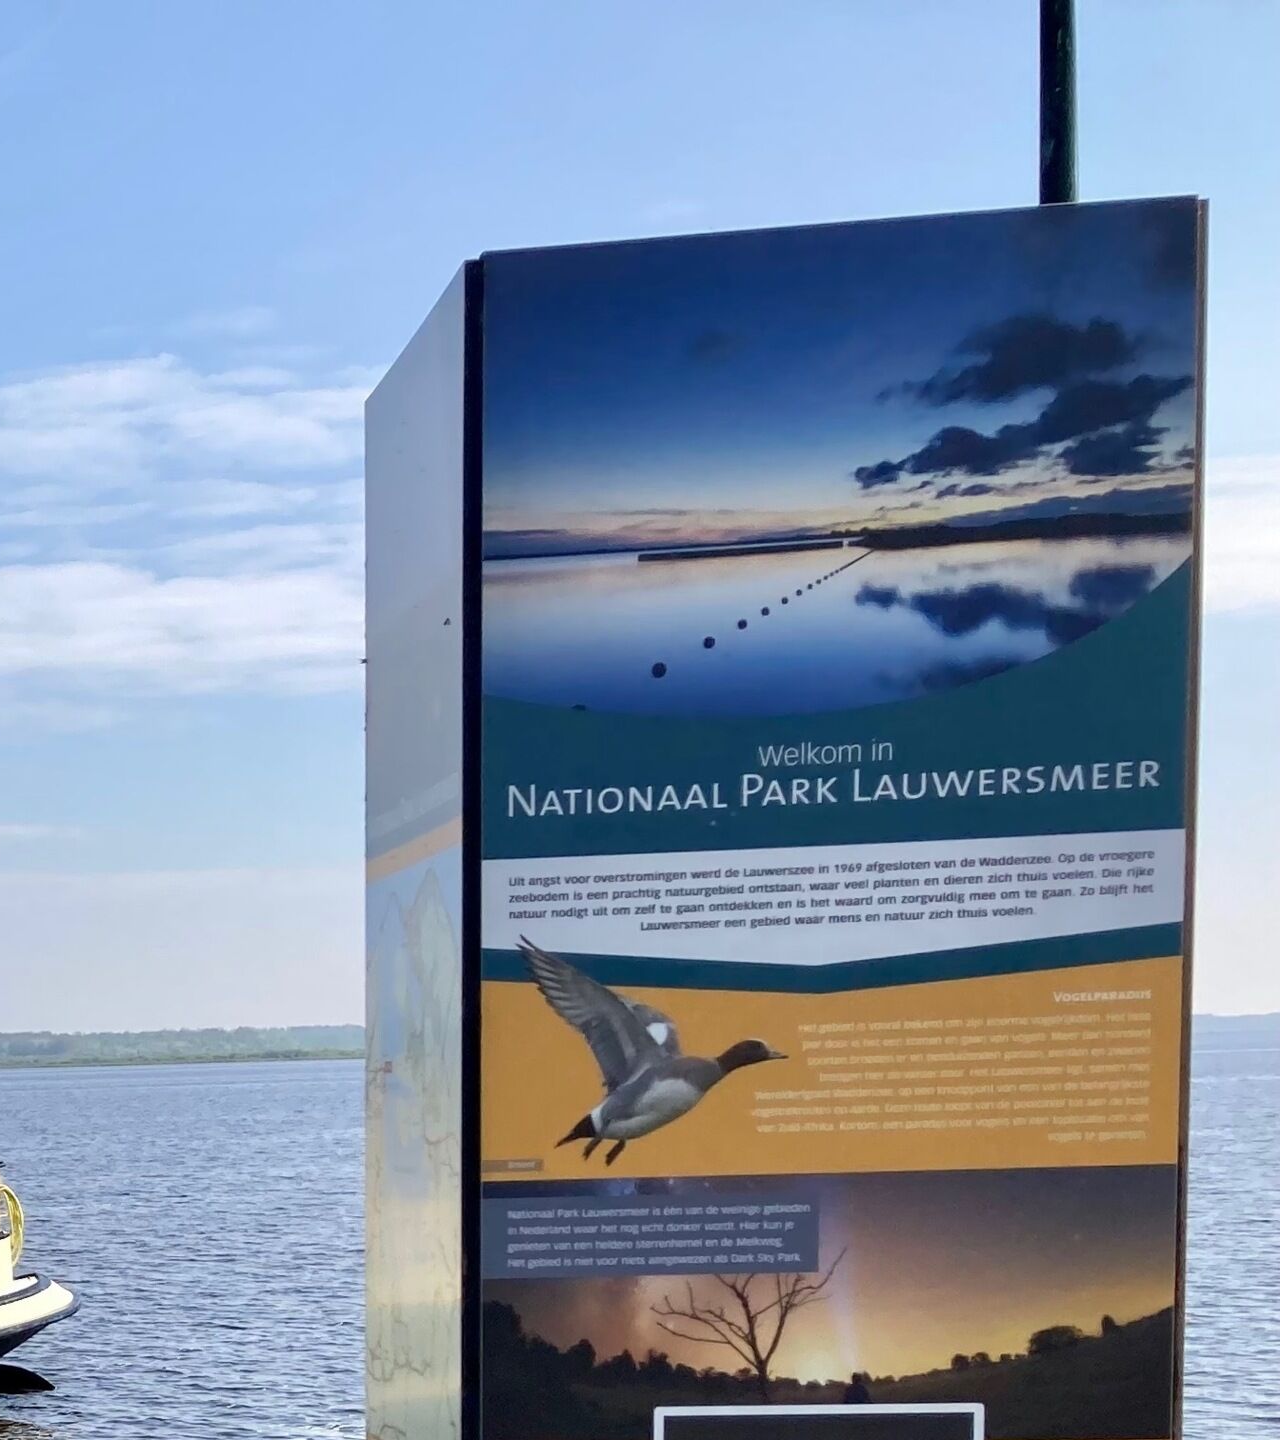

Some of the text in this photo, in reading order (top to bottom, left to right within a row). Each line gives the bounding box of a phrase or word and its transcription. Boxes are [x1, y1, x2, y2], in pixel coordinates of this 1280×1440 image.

[758, 739, 893, 768] Welkom in
[508, 760, 1160, 818] NATIONAAL PARK LAUWERSMEER
[508, 876, 526, 887] Uit
[528, 875, 561, 888] angst
[563, 875, 592, 885] voor
[593, 871, 687, 884] overstromingen
[690, 868, 722, 880] werd
[724, 867, 740, 879] de
[742, 866, 815, 878] Lauwerszee
[818, 864, 830, 875] in
[834, 862, 863, 874] 1969
[865, 860, 931, 874] afgesloten
[933, 859, 957, 869] van
[959, 857, 976, 868] de
[1057, 853, 1076, 864] Op
[1079, 852, 1096, 863] de
[1098, 850, 1155, 863] vroegere
[508, 892, 570, 904] zeebodem
[573, 890, 583, 901] is
[586, 891, 609, 901] een
[611, 888, 662, 901] prachtig
[664, 884, 745, 898] natuurgebied
[808, 881, 841, 892] waar
[843, 879, 869, 890] veel
[872, 878, 920, 891] planten
[923, 877, 940, 887] en
[943, 874, 984, 886] dieren
[987, 872, 1013, 884] zich
[1016, 871, 1048, 882] thuis
[1101, 868, 1123, 879] Die
[1126, 866, 1155, 879] rijke
[508, 909, 548, 920] natuur
[550, 907, 589, 920] nodigt
[592, 906, 609, 917] uit
[611, 906, 631, 916] om
[634, 903, 656, 916] zelf
[659, 904, 673, 914] te
[675, 903, 705, 916] gaan
[708, 900, 773, 912] ontdekken
[777, 900, 793, 910] en
[796, 899, 807, 909] is
[810, 897, 830, 908] het
[834, 895, 873, 907] waard
[877, 895, 897, 906] om
[900, 891, 965, 906] zorgvuldig
[969, 891, 997, 902] mee
[1000, 890, 1021, 900] om
[1024, 889, 1038, 899] te
[1079, 886, 1096, 897] Zo
[1098, 883, 1129, 897] blijft
[1132, 883, 1154, 894] het
[640, 919, 722, 932] Lauwersmeer
[724, 918, 747, 929] een
[750, 915, 791, 929] gebied
[794, 915, 826, 925] waar
[828, 914, 862, 924] mens
[864, 913, 881, 922] en
[884, 911, 926, 922] natuur
[928, 909, 954, 920] zich
[956, 908, 988, 919] thuis
